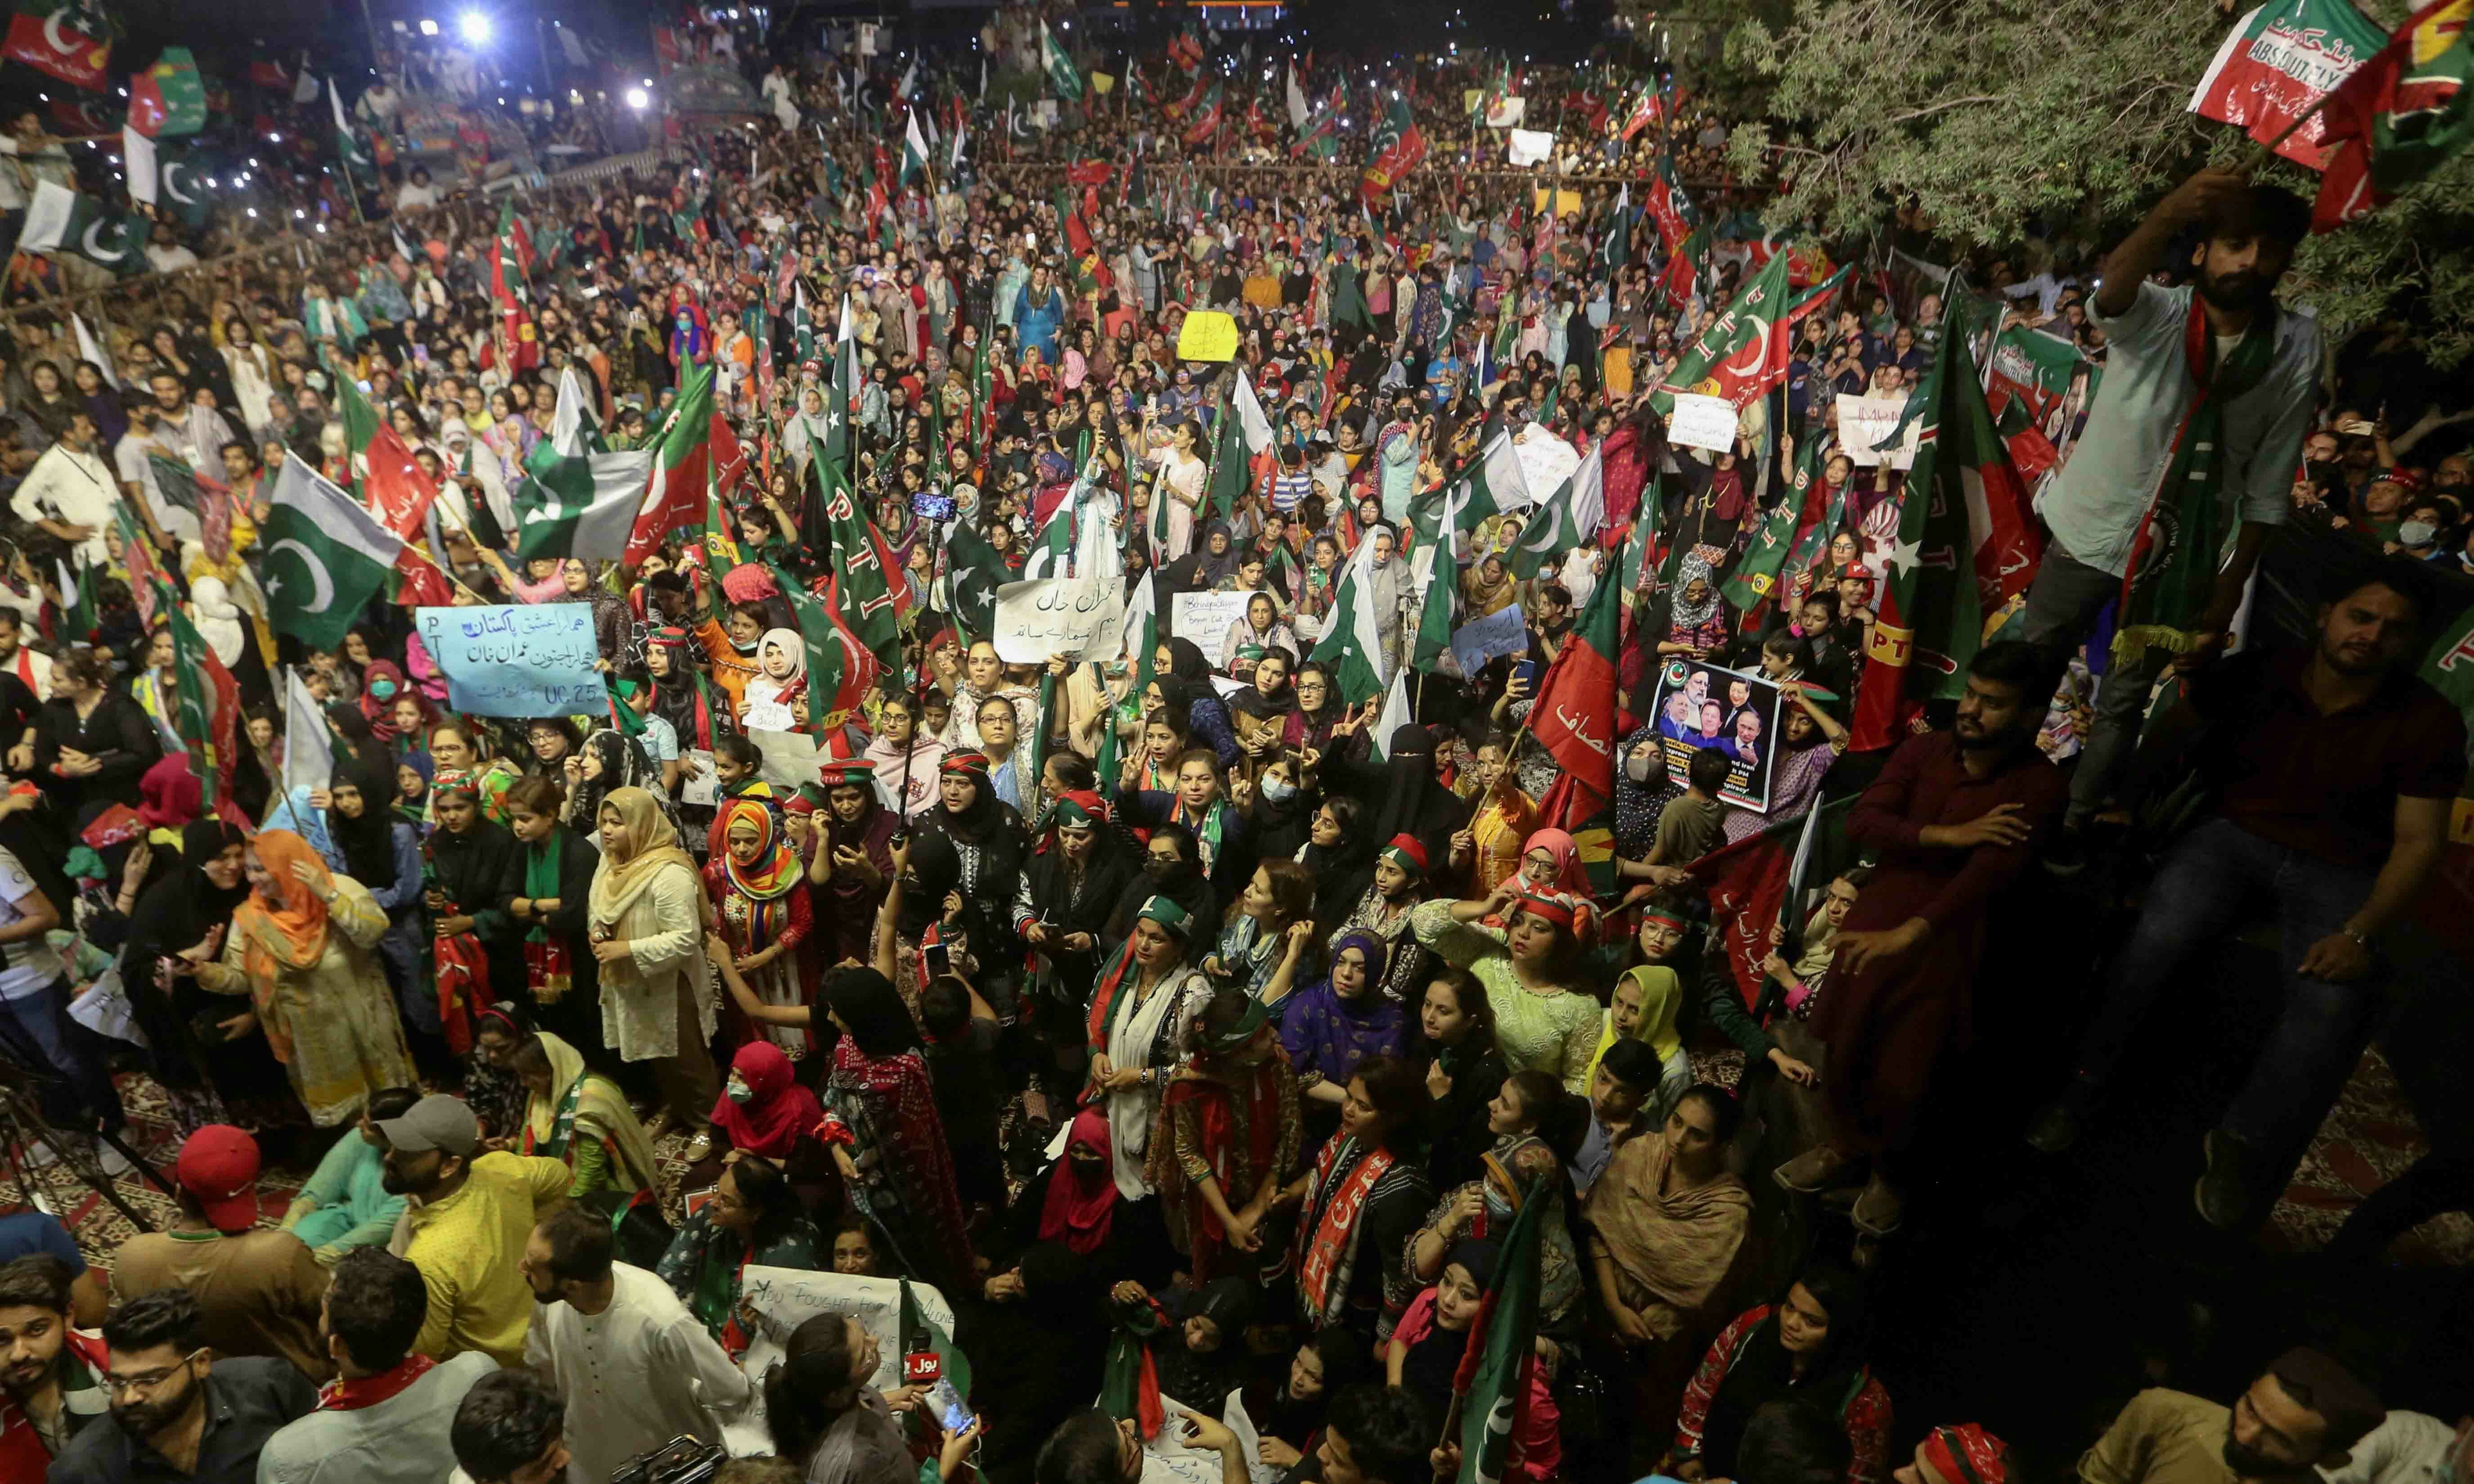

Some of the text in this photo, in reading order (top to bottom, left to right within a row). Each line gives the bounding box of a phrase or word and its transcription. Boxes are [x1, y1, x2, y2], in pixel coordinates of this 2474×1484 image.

[1037, 583, 1116, 612] عمران خان
[462, 608, 516, 638] پاکستان
[1098, 617, 1116, 643] ہم
[467, 645, 494, 663] خان
[496, 642, 528, 662] عمران
[529, 648, 565, 669] جنون
[545, 684, 597, 705] UC 25
[1556, 703, 1613, 760] نصاف
[1666, 739, 1682, 749] ussia,
[1741, 762, 1755, 771] Iran
[1667, 764, 1683, 773] ainst
[1738, 769, 1749, 778] PM
[914, 1359, 937, 1374] بول
